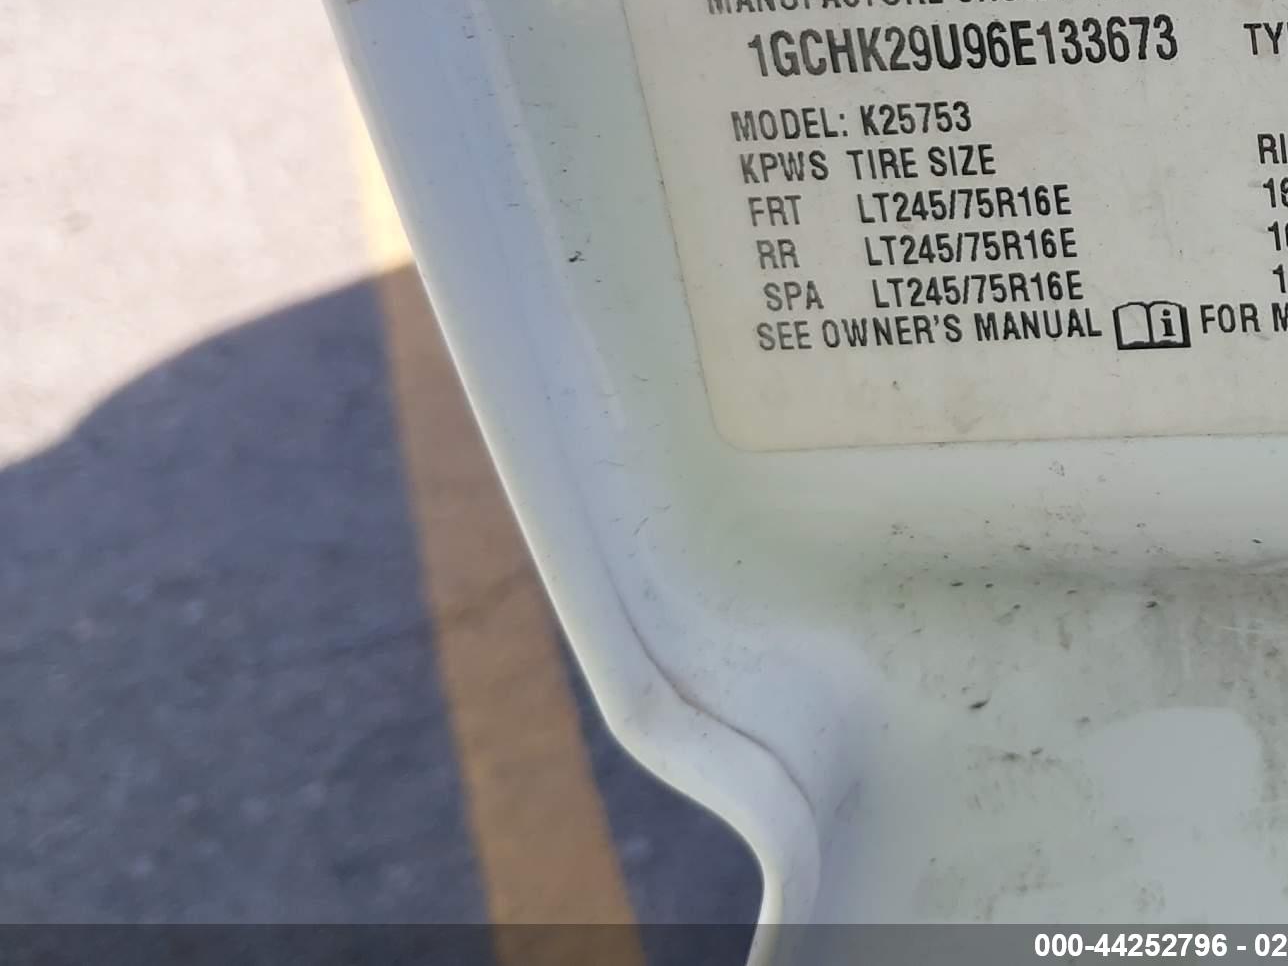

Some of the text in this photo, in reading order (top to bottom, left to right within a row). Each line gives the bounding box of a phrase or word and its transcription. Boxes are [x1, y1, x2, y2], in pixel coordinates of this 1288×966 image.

[748, 14, 1178, 77] 1GCHK29U96E133673
[731, 101, 971, 141] MODEL: K25753
[740, 144, 996, 184] KPWS TIRE SIZE
[748, 184, 1071, 227] FRT LT245/75R16E
[756, 228, 1077, 269] RR LT245/75R16E
[763, 270, 1083, 311] SPA LT245/75R16E
[757, 321, 812, 351] SEE
[822, 314, 962, 348] OWNER'S
[974, 308, 1102, 341] MANUAL
[1200, 303, 1261, 333] FOR
